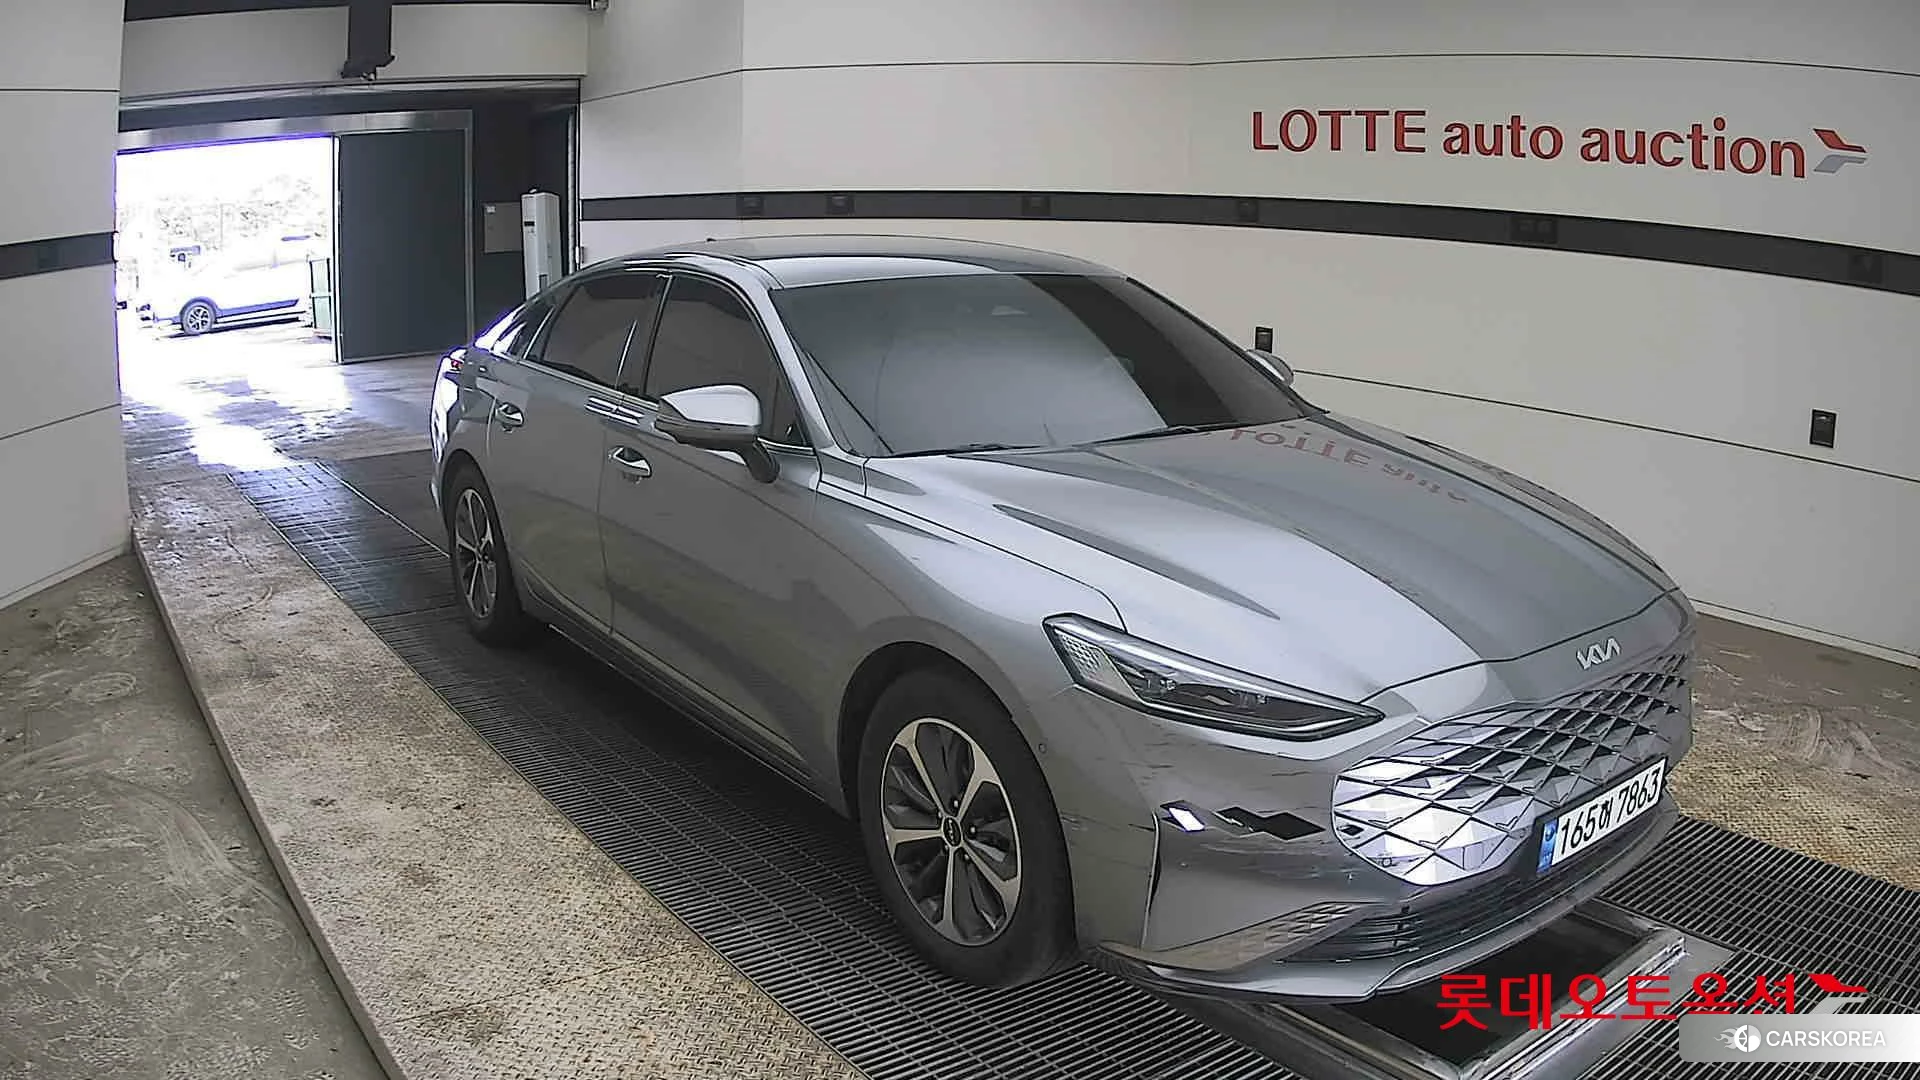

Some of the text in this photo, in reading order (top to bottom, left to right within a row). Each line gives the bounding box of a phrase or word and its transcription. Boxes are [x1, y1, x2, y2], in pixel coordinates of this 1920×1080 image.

[1251, 109, 1806, 178] LOTTE auto auction
[1576, 637, 1622, 670] KIA
[1616, 767, 1661, 824] 7863
